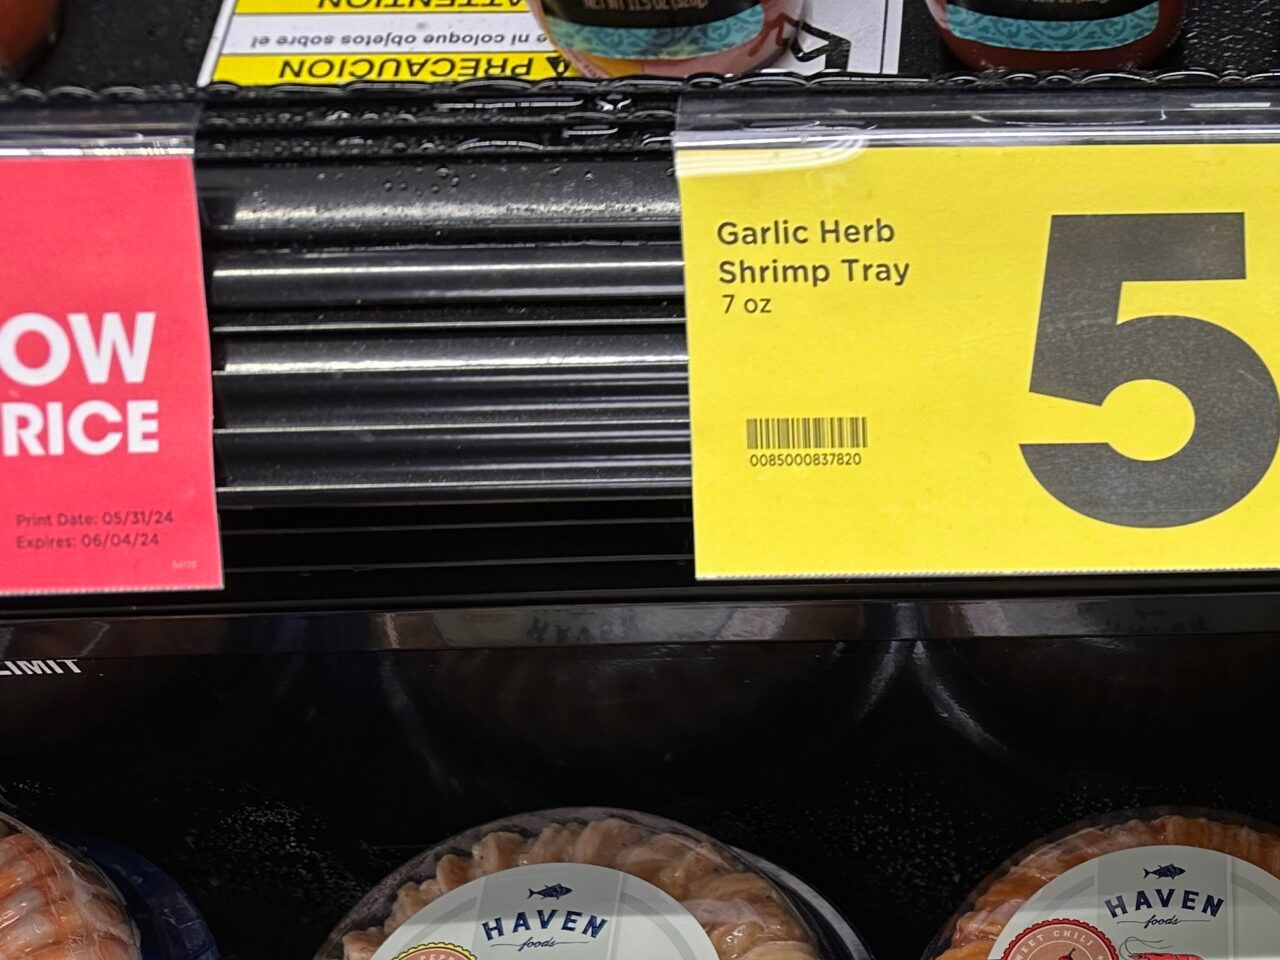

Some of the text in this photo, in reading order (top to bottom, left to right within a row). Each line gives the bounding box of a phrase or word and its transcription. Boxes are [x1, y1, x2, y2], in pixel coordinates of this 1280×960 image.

[251, 35, 270, 48] el
[276, 34, 333, 47] sobre
[341, 32, 415, 47] objetos
[423, 32, 505, 45] coloque
[512, 33, 529, 45] ni
[278, 57, 533, 79] PRECAUCION
[717, 218, 895, 245] Garlic Herb
[719, 258, 910, 287] Shrimp Tray
[722, 294, 772, 314] 7 oz
[749, 452, 862, 467] 0085000837820
[16, 511, 174, 527] Print Date: 05/31/24
[16, 533, 160, 550] Expires: 06/04/24
[1104, 888, 1224, 919] HAVEN
[482, 909, 608, 941] HAVEN
[1053, 929, 1094, 947] CHILI
